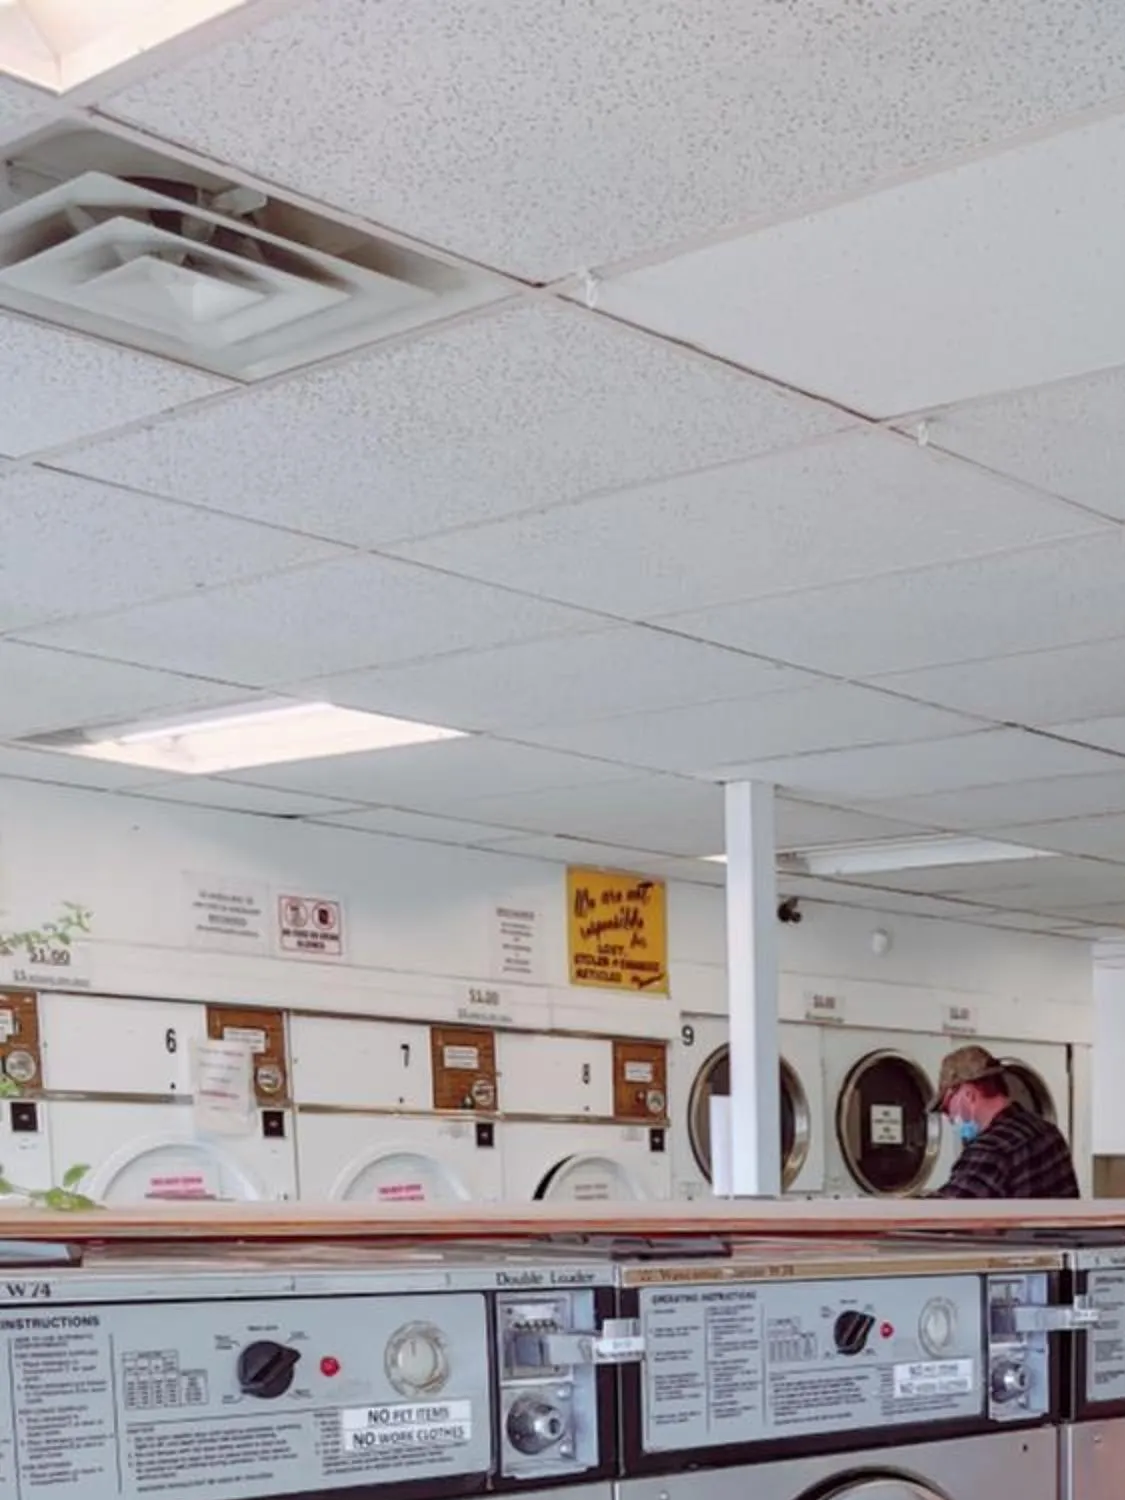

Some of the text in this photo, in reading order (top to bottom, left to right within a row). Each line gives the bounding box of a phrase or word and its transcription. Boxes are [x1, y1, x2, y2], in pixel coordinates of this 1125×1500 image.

[165, 1027, 177, 1054] 6
[680, 1024, 695, 1046] 9
[400, 1043, 410, 1068] 7
[582, 1062, 591, 1085] 8
[495, 1270, 596, 1286] Double Loader
[0, 1314, 100, 1331] INSTRUCTIONS
[367, 1408, 390, 1424] NO
[415, 1406, 450, 1421] ITEMS
[352, 1425, 465, 1447] NO WORK CLOTHES
